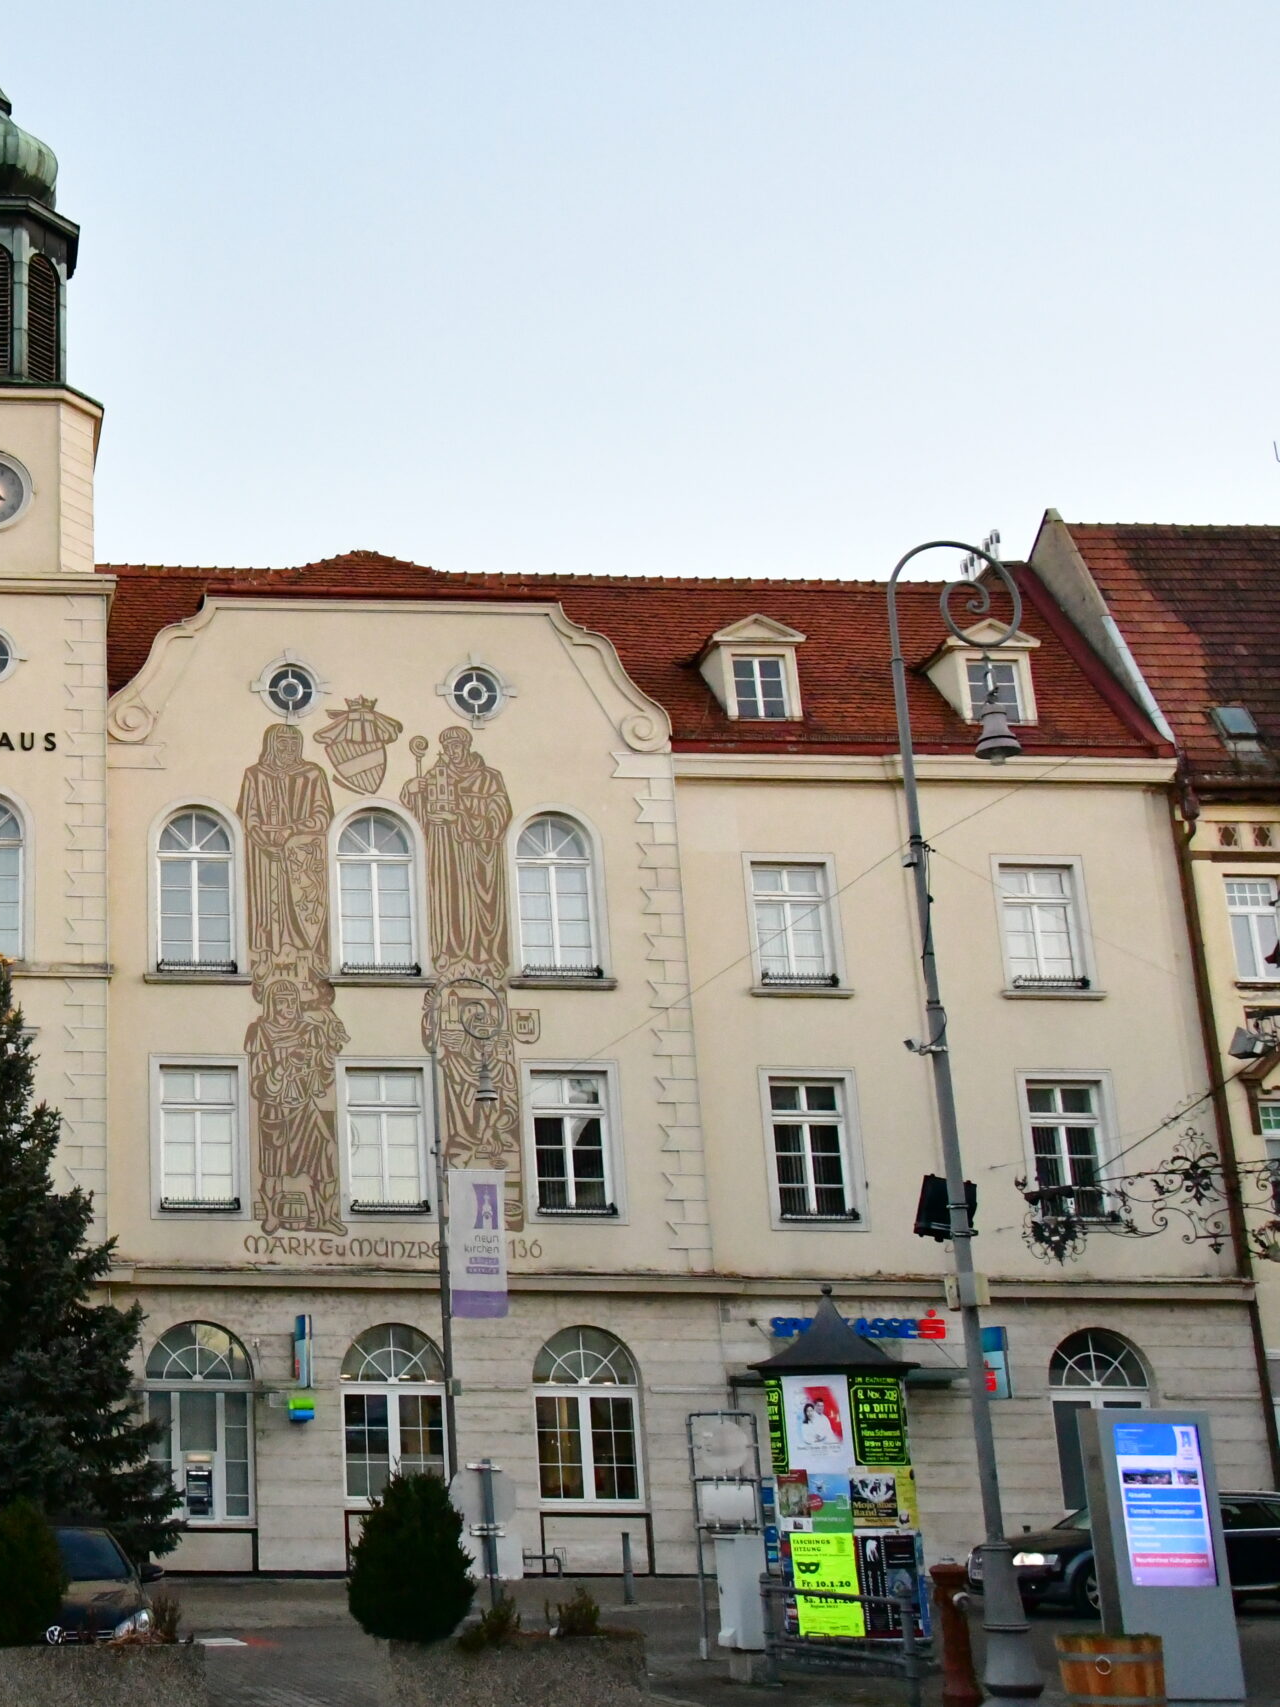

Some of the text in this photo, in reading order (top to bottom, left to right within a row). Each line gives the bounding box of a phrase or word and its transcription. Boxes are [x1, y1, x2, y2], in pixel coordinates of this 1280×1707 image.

[474, 1234, 499, 1243] neun
[243, 1235, 334, 1257] MARKT
[464, 1244, 500, 1254] kirchen
[771, 1317, 919, 1339] SPAASSE
[853, 1501, 876, 1511] Mojo
[854, 1509, 877, 1517] Band
[801, 1579, 852, 1588] Fr. 10.1.20
